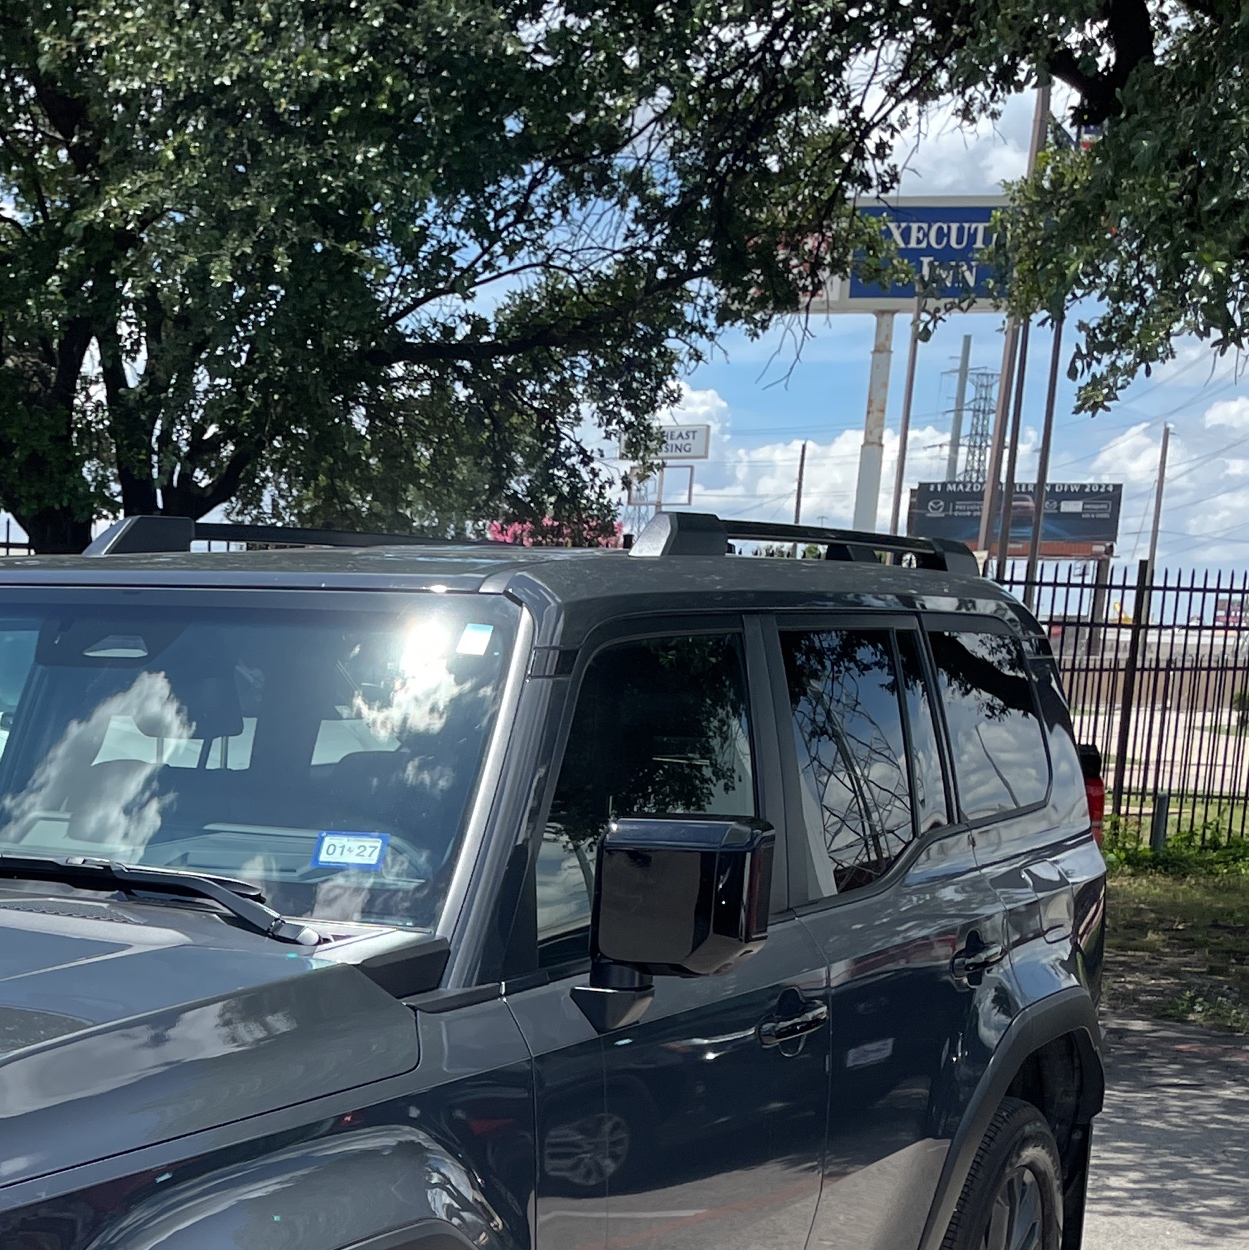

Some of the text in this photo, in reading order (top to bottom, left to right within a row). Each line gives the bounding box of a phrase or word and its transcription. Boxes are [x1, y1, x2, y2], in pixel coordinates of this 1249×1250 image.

[886, 221, 998, 249] XECUT
[1055, 484, 1081, 493] DFW
[1084, 484, 1114, 493] 2024
